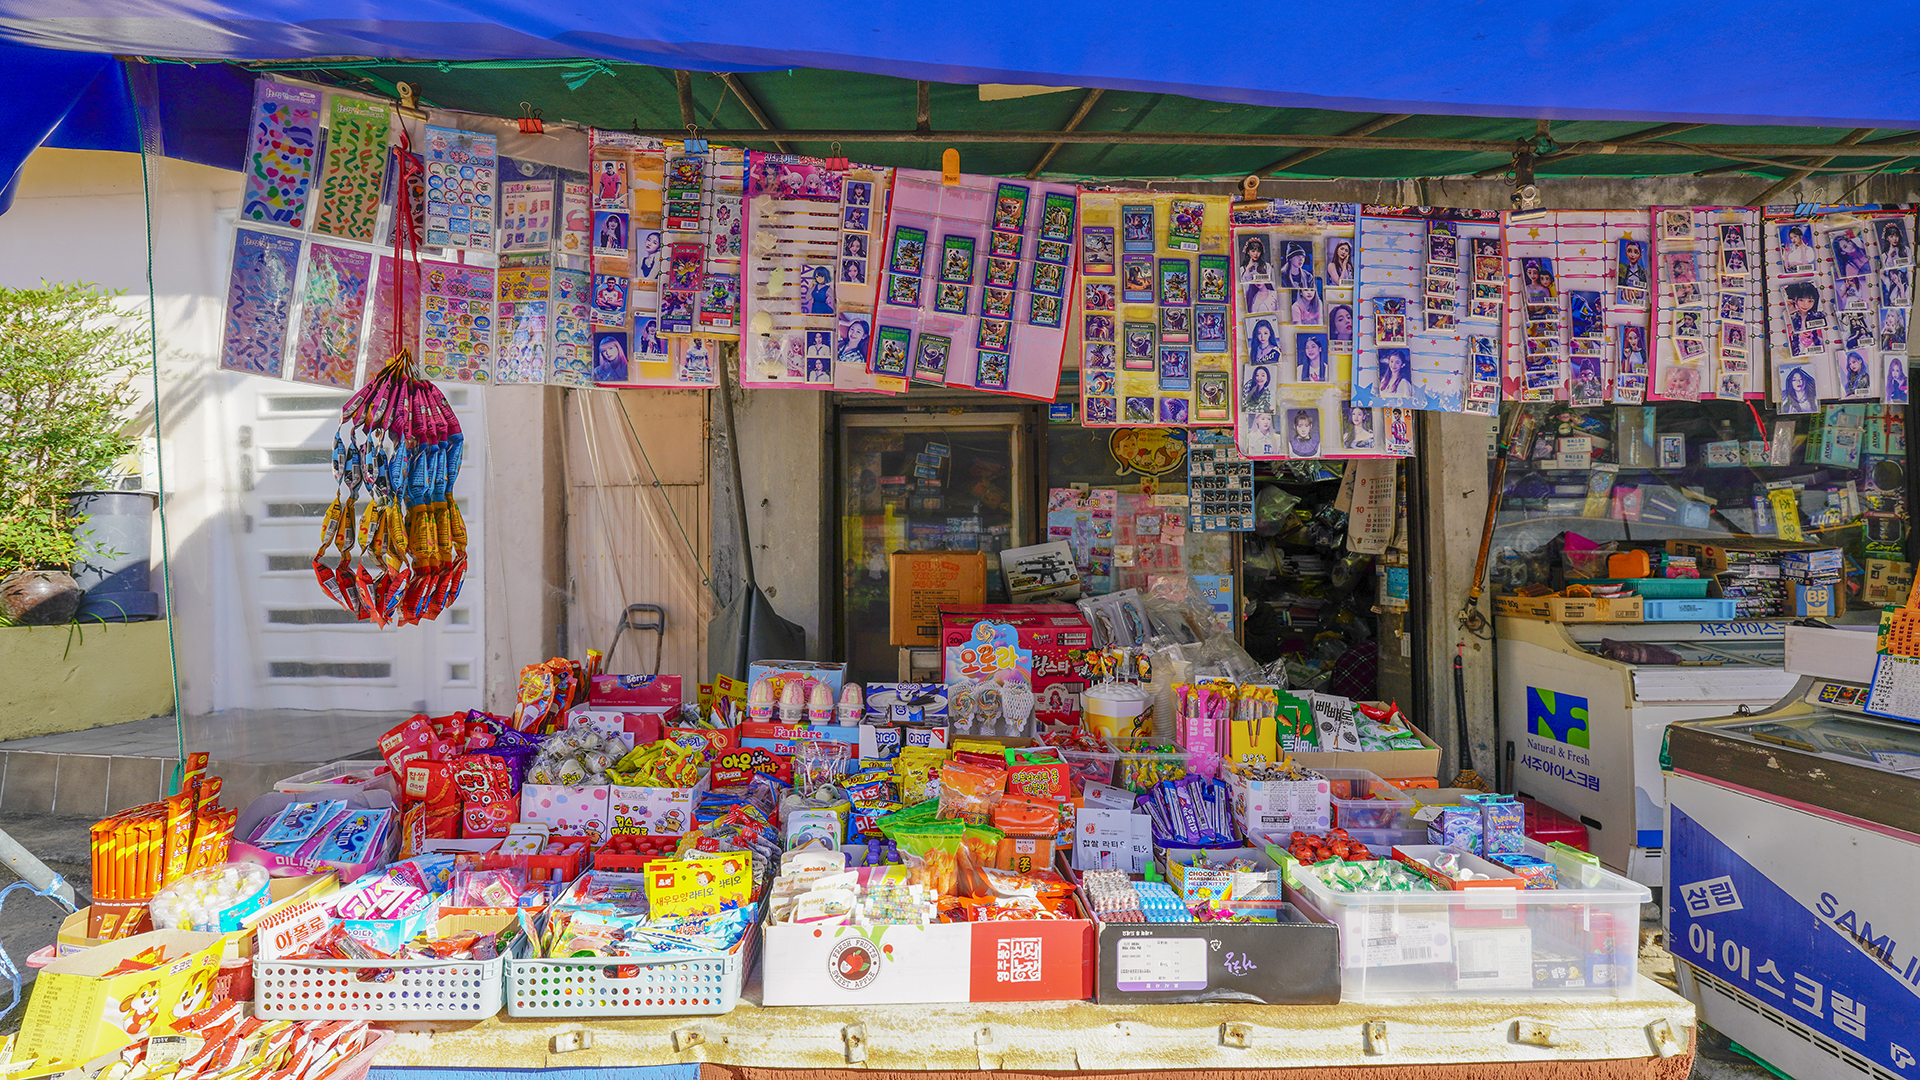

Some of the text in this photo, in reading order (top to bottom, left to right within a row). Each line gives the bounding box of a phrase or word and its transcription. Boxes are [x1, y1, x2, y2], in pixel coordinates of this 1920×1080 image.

[1807, 590, 1828, 602] BB
[960, 645, 1018, 674] 오로라
[626, 674, 648, 684] Berry
[774, 726, 822, 739] Fanfare
[876, 732, 897, 743] RIGO
[909, 733, 930, 744] ORIG
[1527, 738, 1590, 766] Natural & Fresh
[716, 772, 741, 781] Pizza
[1520, 754, 1600, 792] 서주아이스크림
[655, 888, 714, 906] 새우모양 라티오
[275, 916, 326, 951] 아폴로
[1816, 892, 1920, 986] SAMLI
[833, 940, 877, 958] FRESH FRUITS
[997, 939, 1010, 982] 영주풍기
[832, 970, 875, 988] SWEET APPLE
[1688, 923, 1866, 1041] 아이스크림
